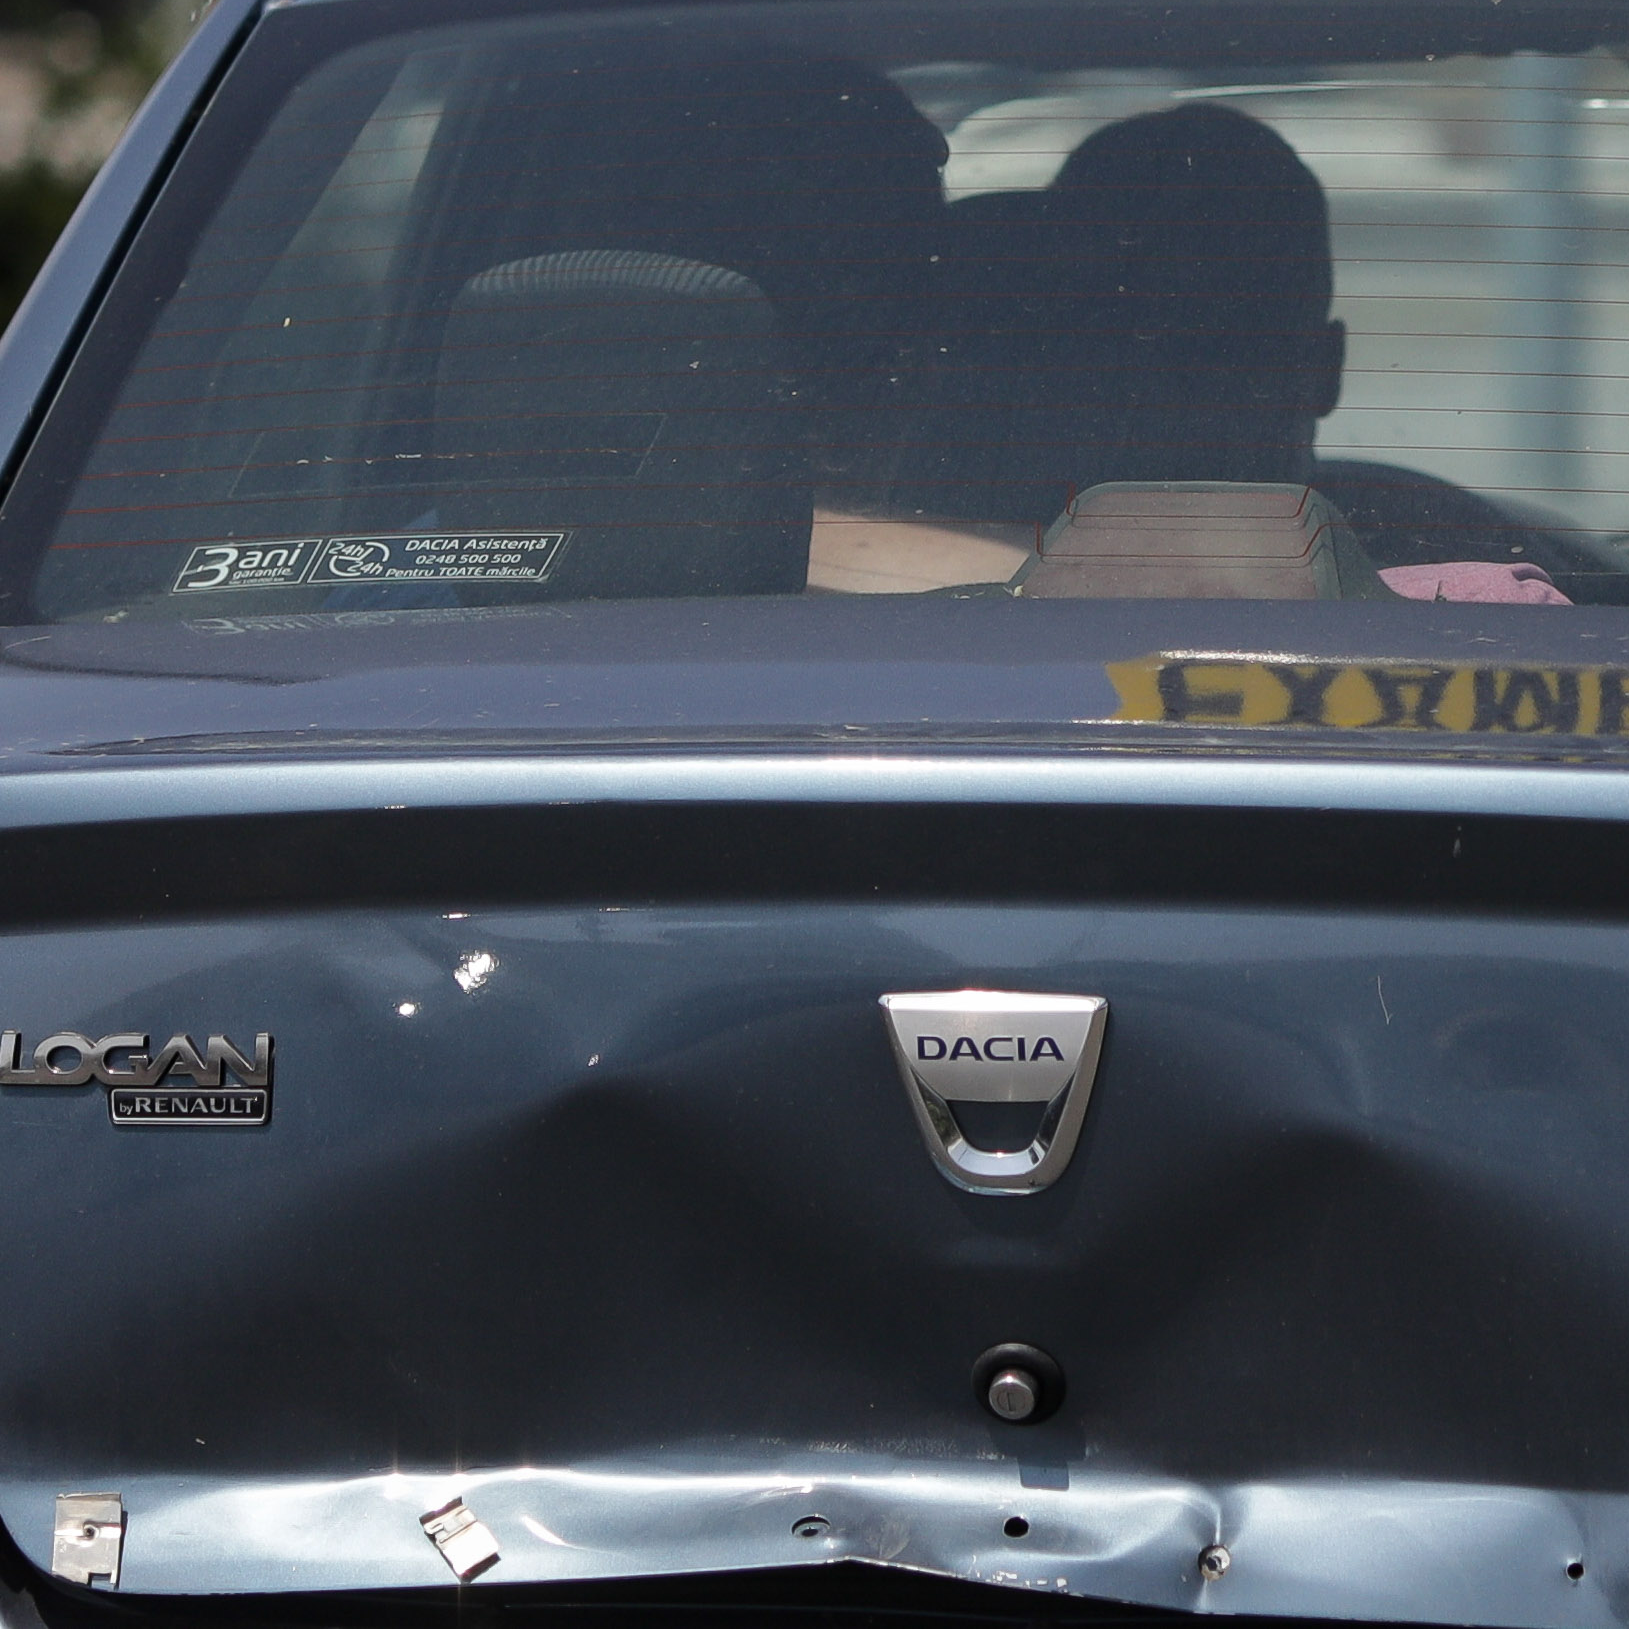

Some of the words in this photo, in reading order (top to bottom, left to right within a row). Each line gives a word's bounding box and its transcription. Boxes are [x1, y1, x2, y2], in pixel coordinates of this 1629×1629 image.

[328, 542, 365, 557] 24h
[404, 539, 460, 552] DACIA
[238, 542, 305, 569] ani
[415, 554, 457, 565] 0248
[458, 554, 489, 564] 500
[490, 554, 522, 564] 500
[346, 560, 384, 576] 24h
[385, 568, 434, 578] Pentru
[438, 567, 484, 577] TOATE
[485, 566, 536, 577] mărcile
[916, 1035, 1065, 1062] DACIA
[0, 1030, 271, 1086] LOGAN
[119, 1101, 133, 1115] by
[134, 1096, 258, 1114] RENAULT
